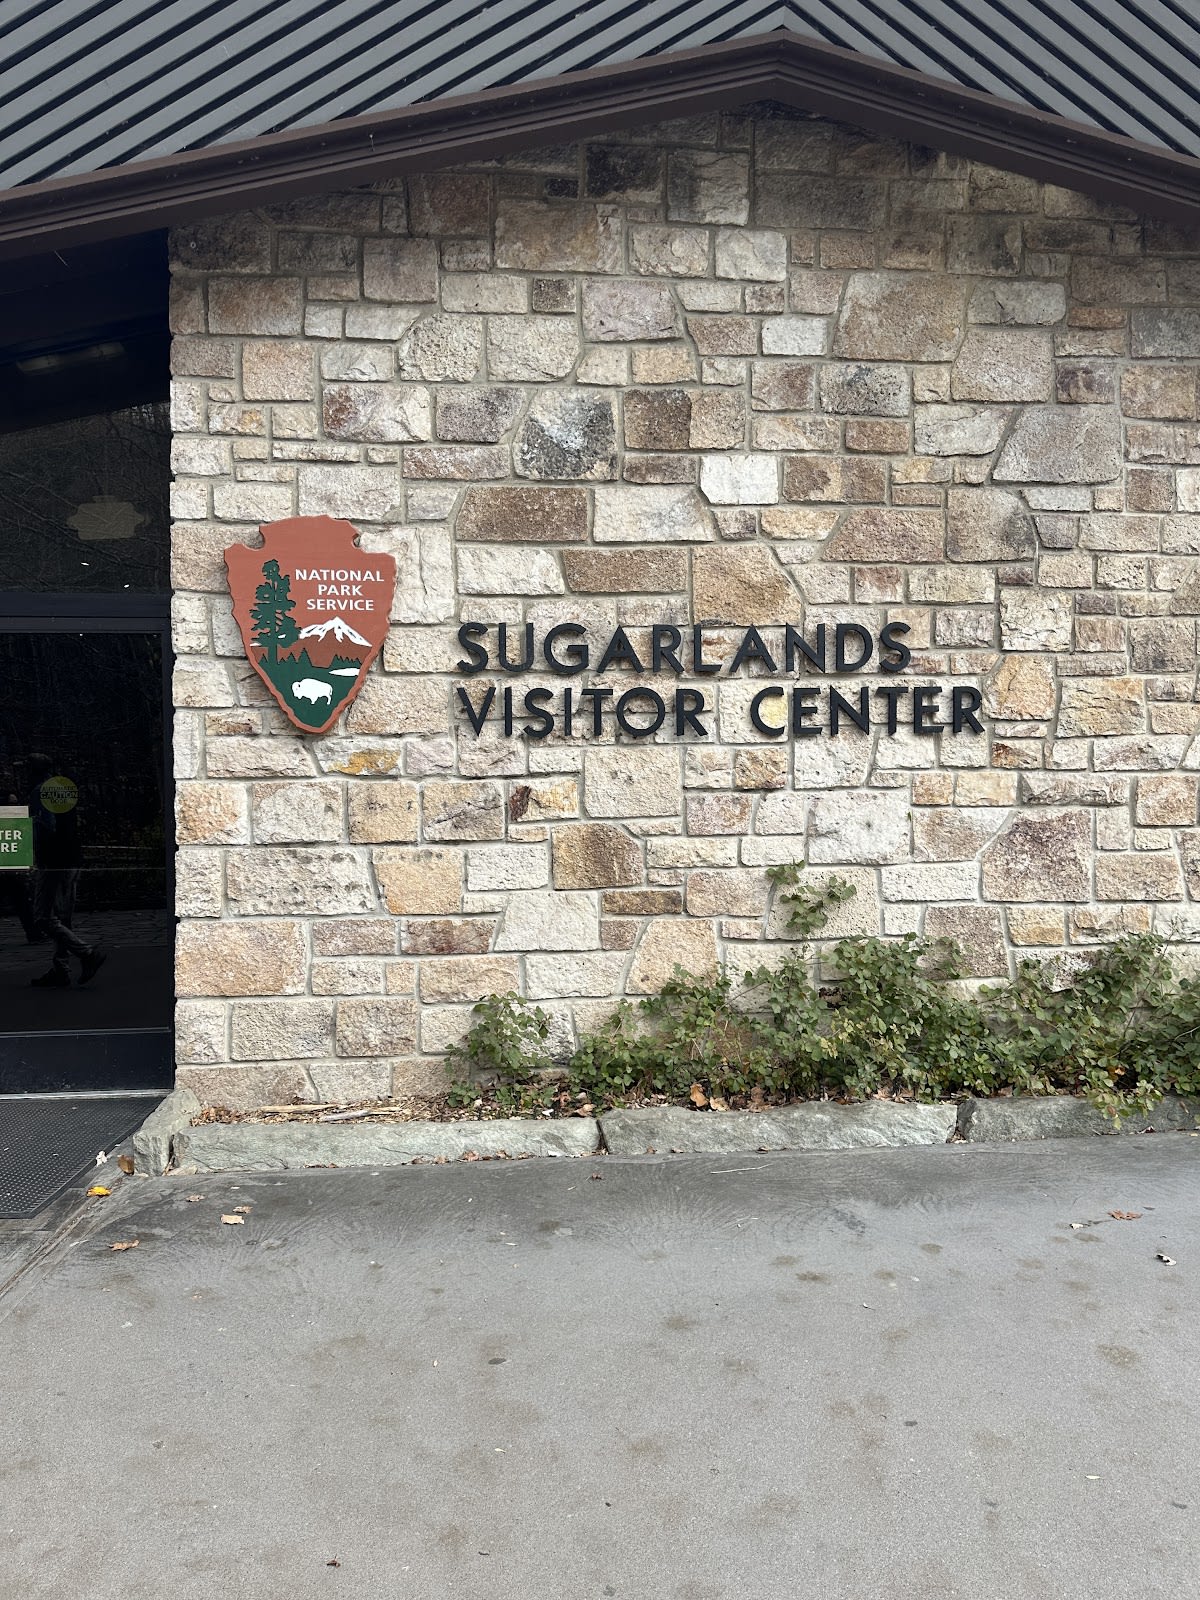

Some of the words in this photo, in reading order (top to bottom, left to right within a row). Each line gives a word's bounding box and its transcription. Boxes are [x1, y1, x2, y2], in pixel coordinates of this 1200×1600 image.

[295, 568, 385, 582] NATIONAL
[318, 584, 363, 596] PARK
[306, 599, 375, 611] SERVICE
[456, 621, 912, 674] SUGARLANDS
[456, 686, 709, 739] VISITOR
[750, 686, 986, 736] CENTER
[40, 791, 79, 799] CAUTION
